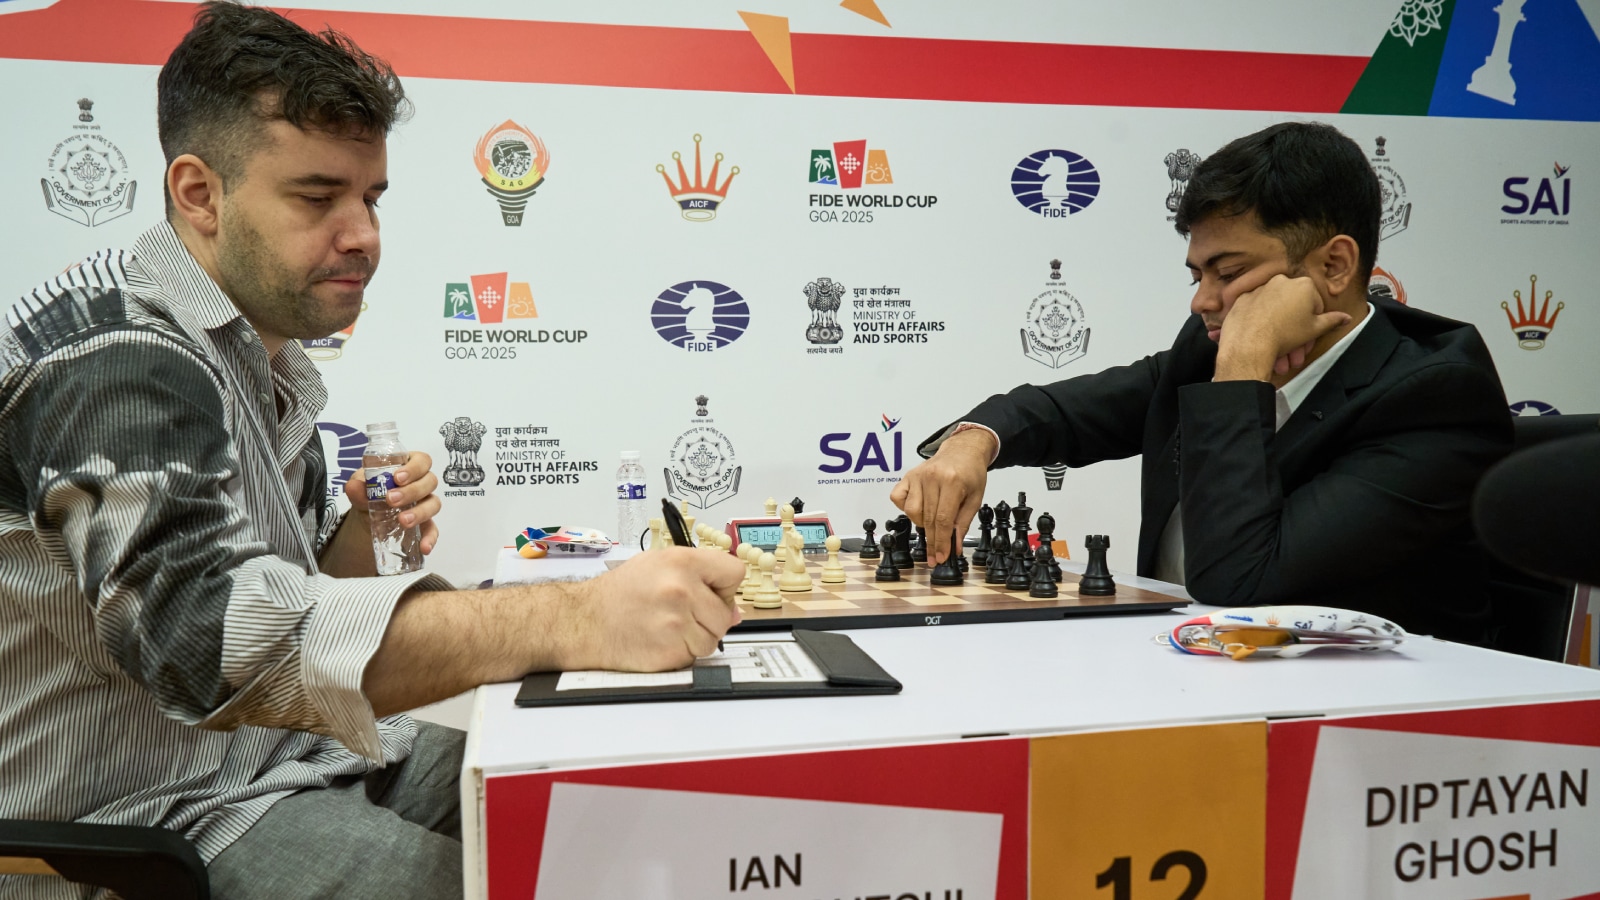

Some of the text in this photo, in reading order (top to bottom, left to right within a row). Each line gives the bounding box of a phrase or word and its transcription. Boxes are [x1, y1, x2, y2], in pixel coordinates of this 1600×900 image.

[53, 181, 126, 207] GOVERNMENT OF GOA
[1501, 177, 1570, 216] SAI
[688, 200, 710, 208] AICF
[809, 194, 938, 208] FIDE WORLD CUP
[809, 210, 874, 223] GOA 2025
[1043, 208, 1067, 218] FIDE
[506, 215, 520, 224] GOA
[853, 288, 867, 298] युवा
[866, 298, 882, 308] खेल
[853, 310, 916, 320] MINISTRY OF
[853, 321, 945, 332] YOUTH AFFAIRS
[311, 338, 333, 346] AICF
[444, 330, 588, 344] FIDE WORLD CUP
[853, 333, 928, 344] AND SPORTS
[1029, 330, 1064, 352] GOVERNMENT
[1072, 330, 1083, 342] GOA
[445, 346, 517, 360] GOA 2025
[687, 342, 713, 352] FIDE
[495, 427, 511, 438] युवा
[510, 437, 528, 448] खेल
[496, 450, 566, 460] MINISTRY OF
[818, 432, 902, 474] SAI
[496, 460, 598, 473] YOUTH AFFAIRS
[496, 473, 580, 486] AND SPORTS
[673, 468, 734, 492] GOVERNMENT OF GOA
[1048, 480, 1060, 488] GOA
[924, 616, 942, 626] DGT
[1366, 768, 1588, 828] DIPTAYAN
[1394, 828, 1558, 883] GHOSH
[729, 852, 802, 892] IAN
[1096, 850, 1208, 900] 12
